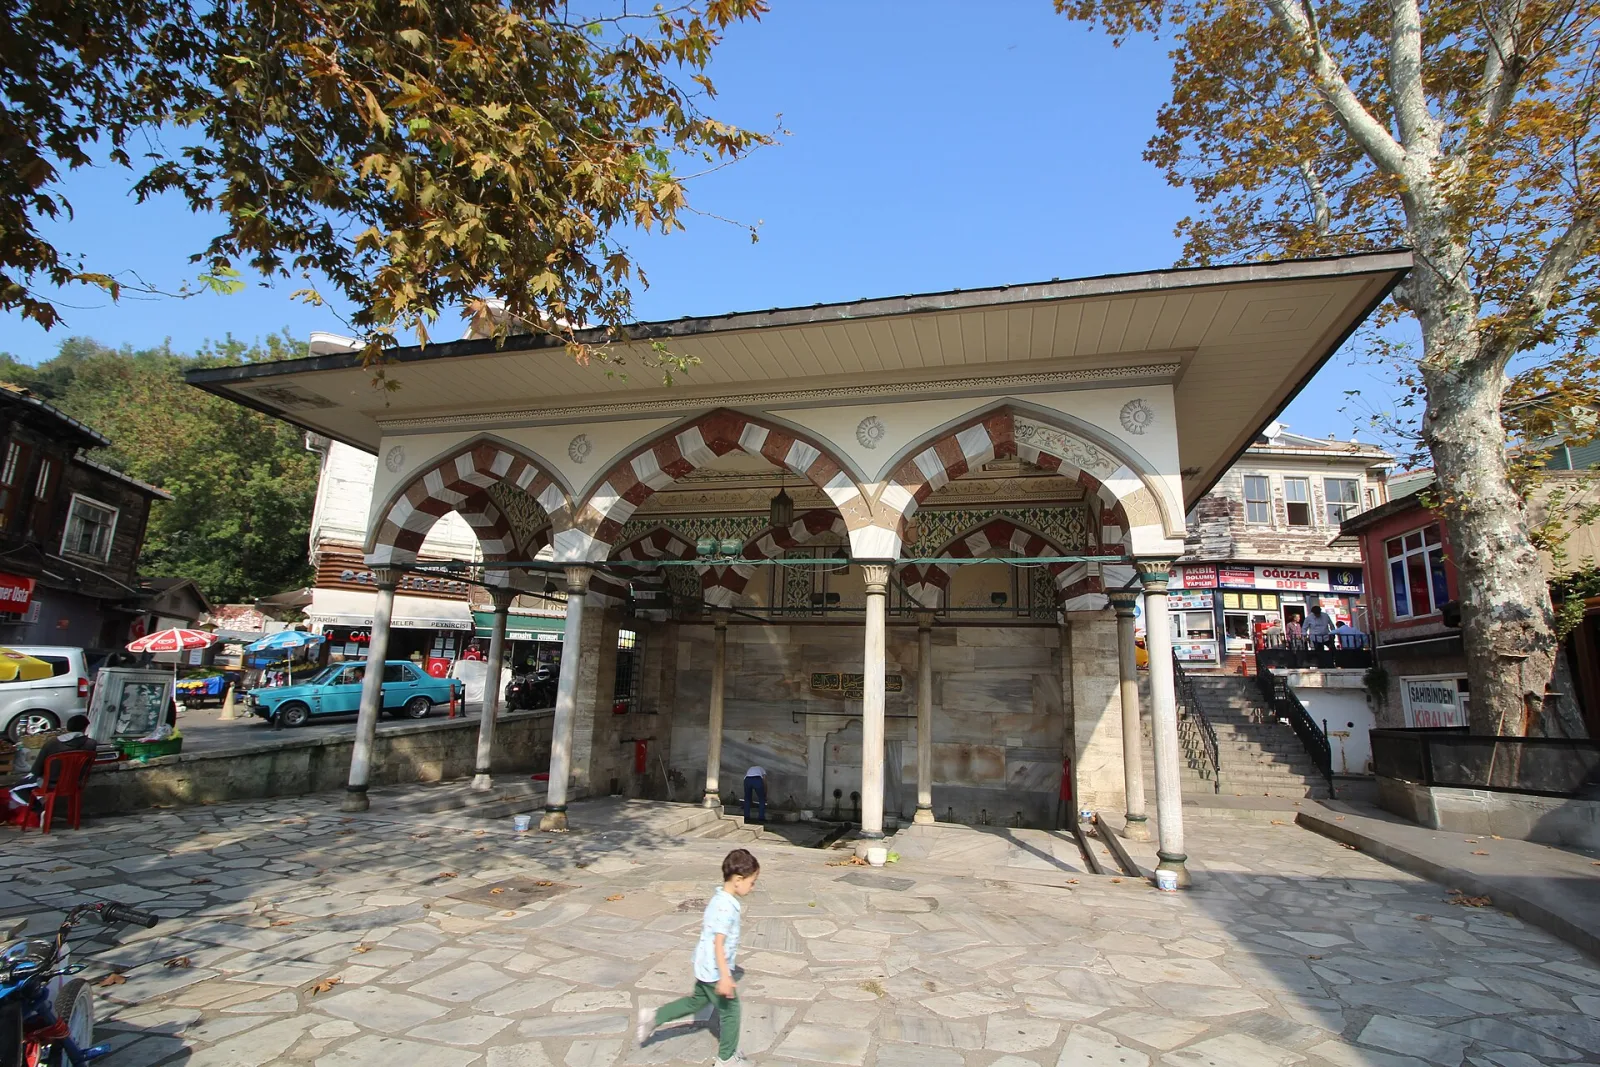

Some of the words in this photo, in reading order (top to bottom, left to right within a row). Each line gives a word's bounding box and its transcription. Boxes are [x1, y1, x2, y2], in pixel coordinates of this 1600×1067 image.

[1186, 566, 1215, 574] AKBİL
[1262, 568, 1320, 580] OĞUZLAR
[1276, 579, 1308, 589] BÜFE
[12, 586, 29, 603] Usta
[313, 616, 338, 624] TARİHİ
[430, 621, 469, 629] PEYNİRCİSİ
[1410, 683, 1454, 704] SAHİBİNDEN
